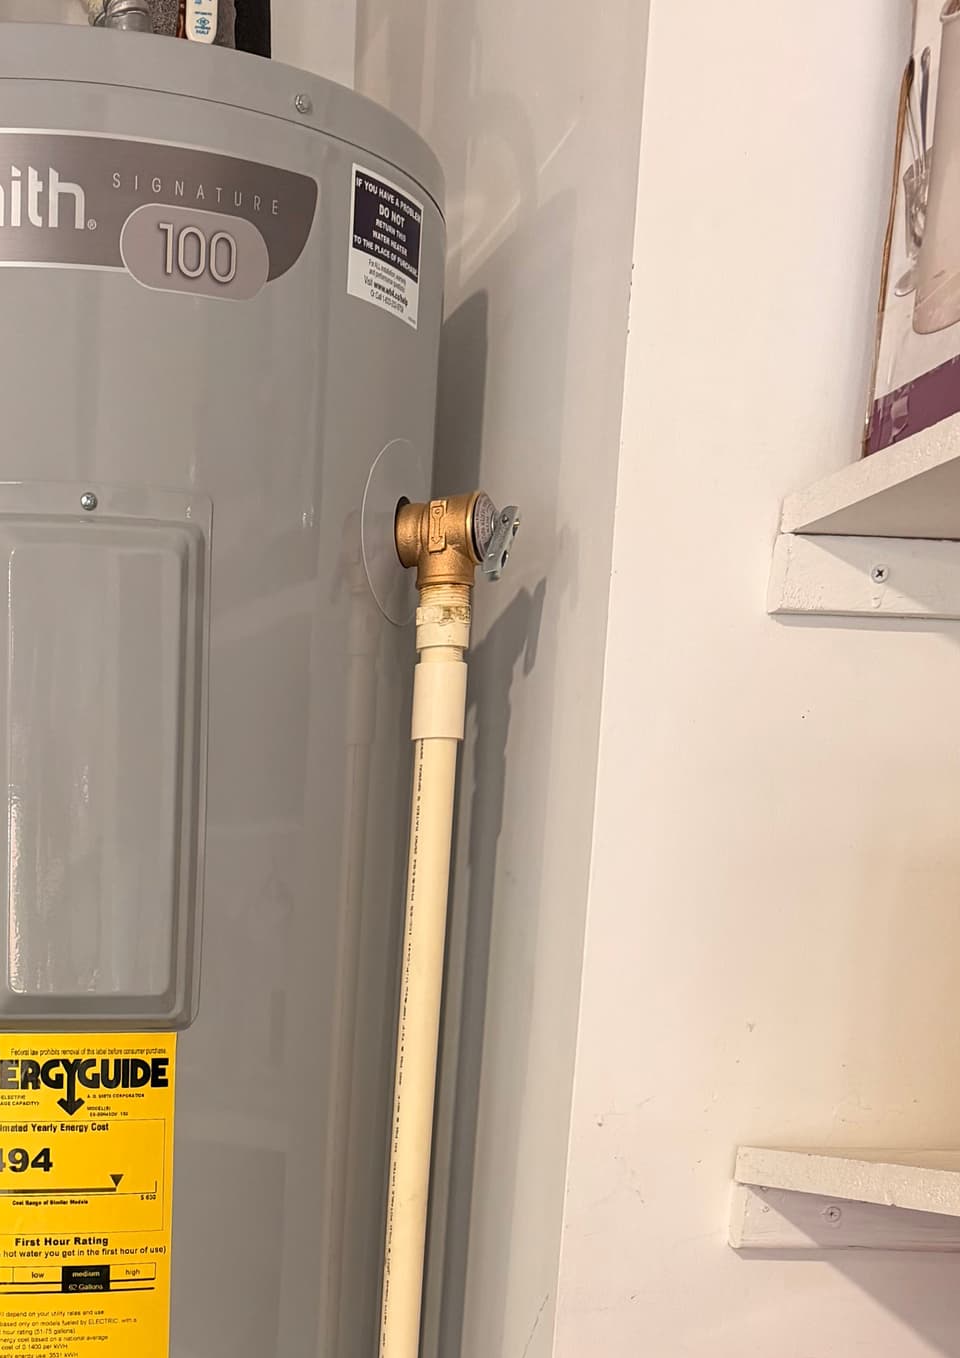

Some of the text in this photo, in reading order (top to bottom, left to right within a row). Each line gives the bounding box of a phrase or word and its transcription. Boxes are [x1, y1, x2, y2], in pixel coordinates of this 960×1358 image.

[112, 172, 280, 216] SIGNATURE
[356, 177, 363, 187] IF
[364, 180, 378, 194] YOU
[379, 187, 395, 204] HAVE
[395, 198, 400, 208] A
[379, 203, 405, 228] DO NOT
[375, 218, 406, 242] RETURN THIS
[159, 223, 238, 283] 100
[354, 234, 362, 244] TO
[362, 238, 374, 250] THE
[374, 243, 390, 259] PLACE
[390, 252, 397, 261] OF
[372, 230, 408, 257] WATER HEATER
[31, 1123, 57, 1133] Yearly
[60, 1123, 89, 1132] Energy
[91, 1122, 109, 1131] Cost
[3, 1250, 17, 1258] hot
[19, 1250, 42, 1258] water
[44, 1251, 60, 1259] you
[62, 1250, 75, 1259] get
[77, 1249, 85, 1257] in
[87, 1248, 100, 1256] the
[101, 1247, 118, 1256] first
[119, 1247, 138, 1255] hour
[140, 1246, 148, 1254] of
[149, 1246, 167, 1254] use)
[15, 1237, 109, 1247] First Hour Rating
[31, 1268, 141, 1279] low medium high
